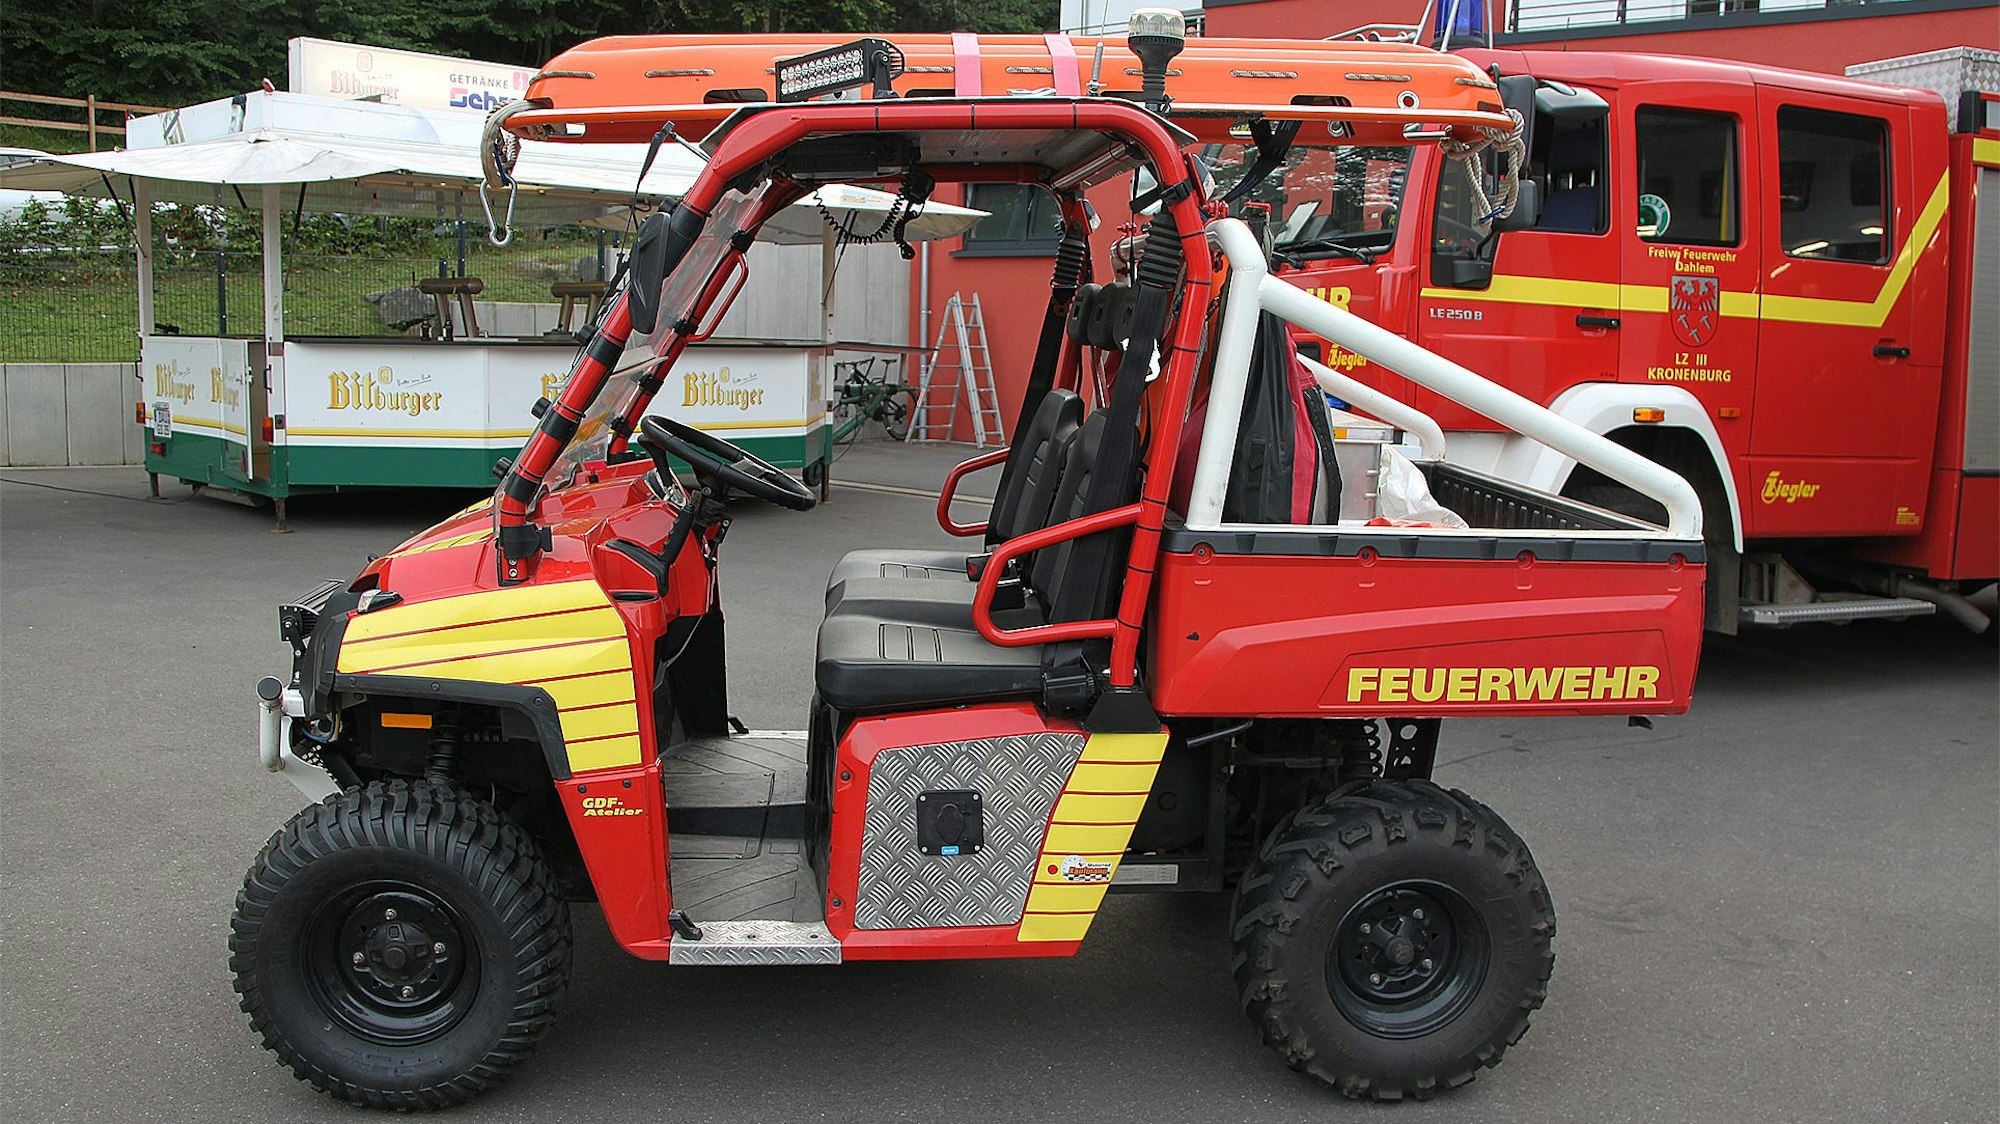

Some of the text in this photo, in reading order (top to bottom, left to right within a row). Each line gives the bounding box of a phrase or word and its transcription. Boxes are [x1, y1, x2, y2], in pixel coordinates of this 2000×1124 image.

[329, 70, 399, 99] Bitburger
[449, 73, 509, 90] GETRÄNKE
[1683, 248, 1737, 262] Feuerwehr
[1675, 260, 1715, 274] Dahlem
[1429, 307, 1483, 321] LE 250 B
[1675, 352, 1708, 366] LZ III
[1647, 367, 1732, 382] KRONENBURG
[327, 371, 442, 417] Bitburger
[681, 371, 764, 410] Bitburger
[1761, 470, 1820, 504] Ziegler
[1346, 665, 1660, 702] FEUERWEHR
[582, 797, 624, 809] GDF-
[583, 808, 643, 817] Atelier
